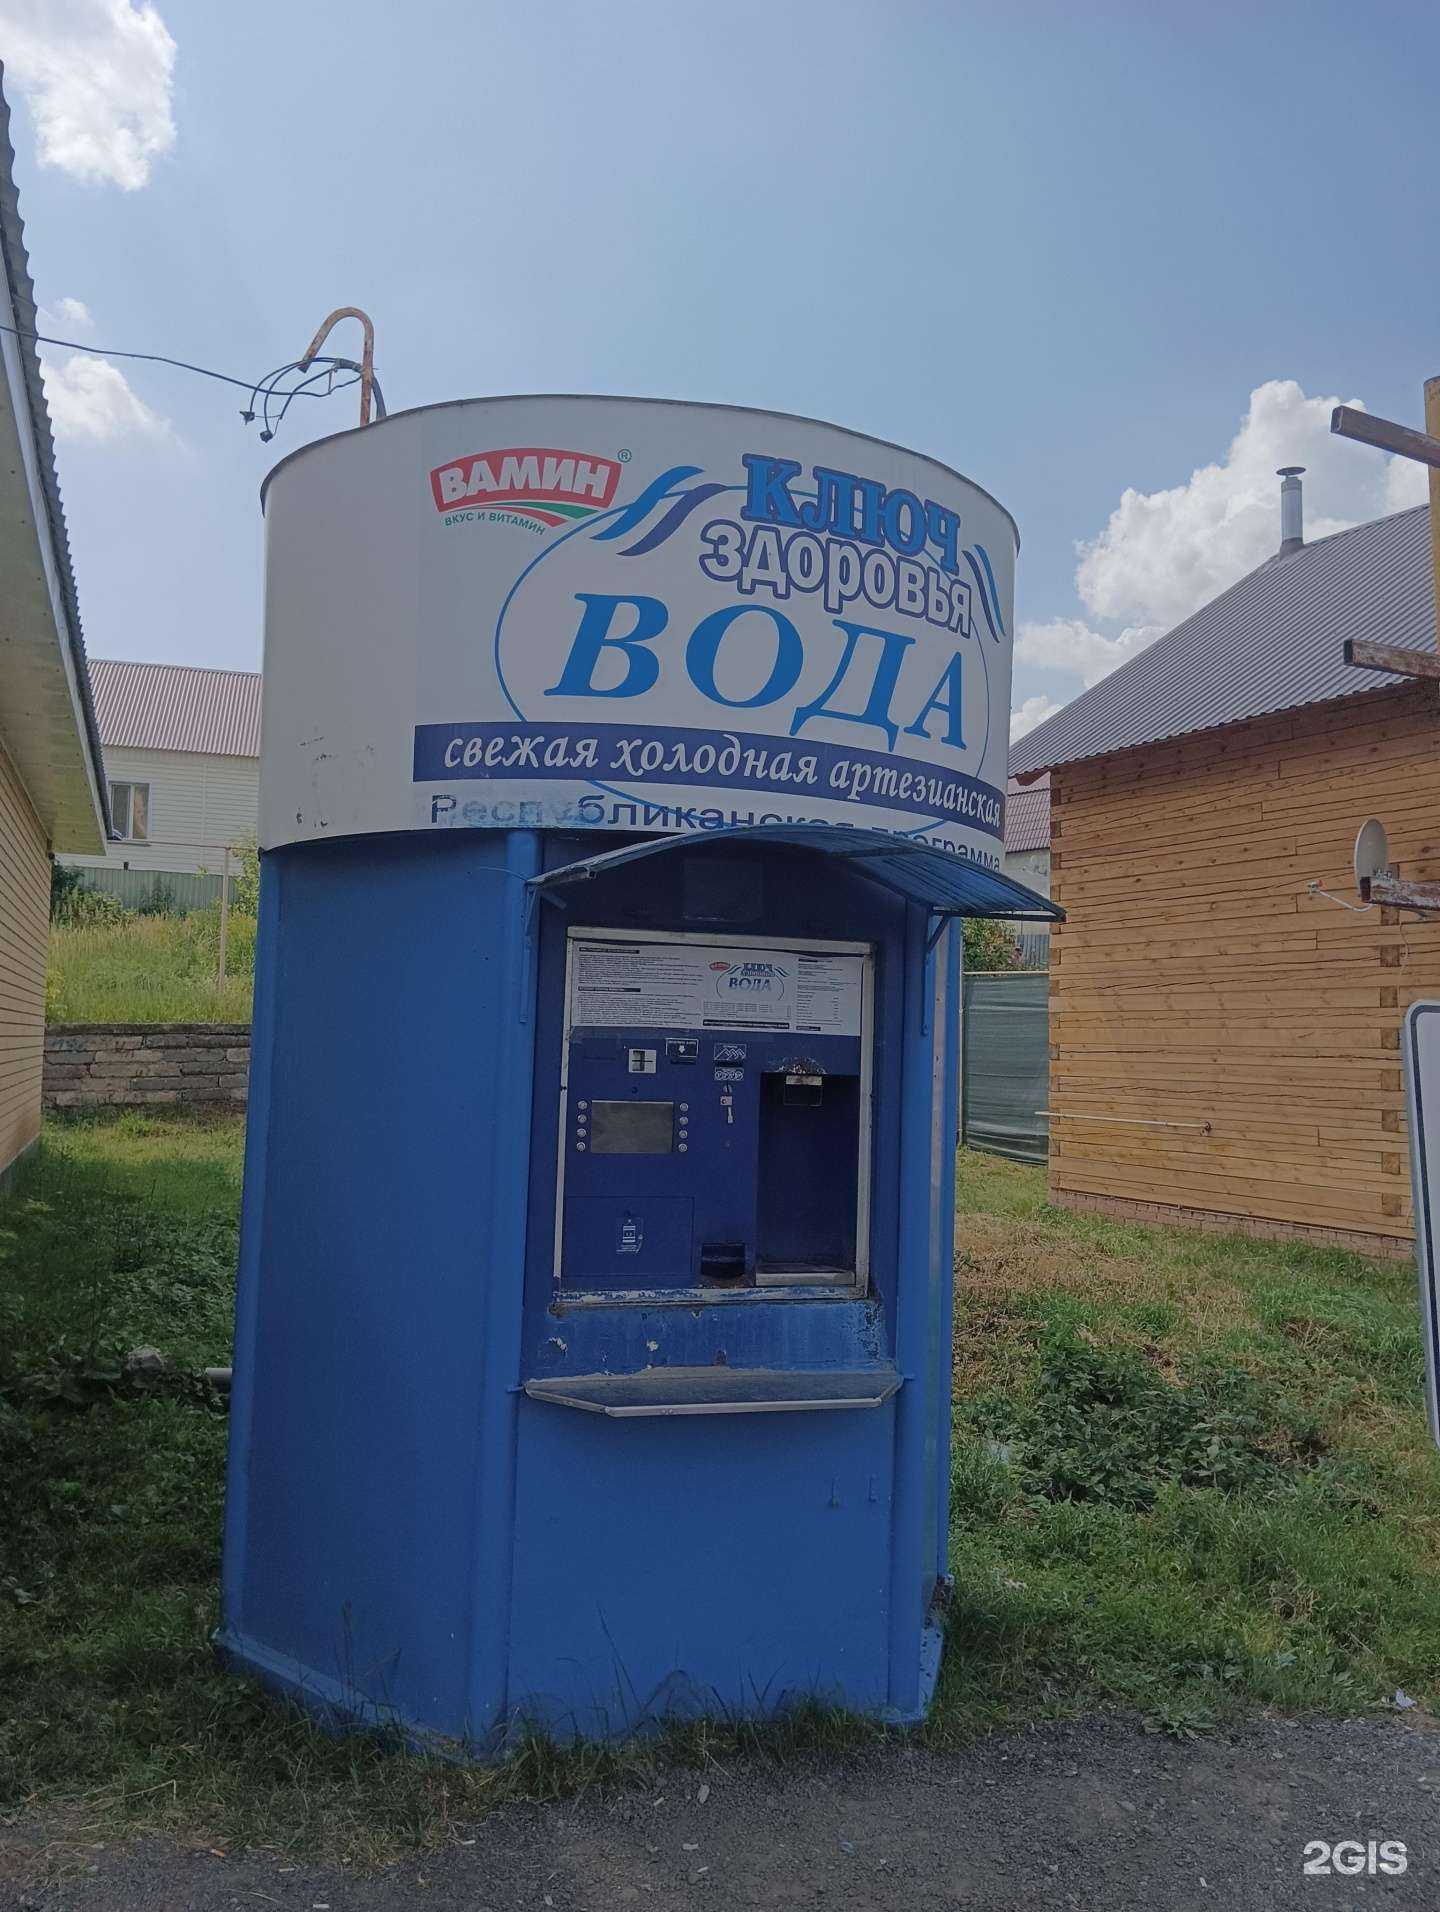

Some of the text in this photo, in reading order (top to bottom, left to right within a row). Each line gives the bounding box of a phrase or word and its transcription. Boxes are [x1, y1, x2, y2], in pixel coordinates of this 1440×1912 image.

[438, 455, 611, 505] ВАМИН
[444, 511, 547, 536] ВКУС И ВИТАМИН
[740, 453, 961, 576] КЛЮЧ
[543, 592, 968, 753] ВОДА
[443, 733, 1001, 829] свежая холодная артезианская
